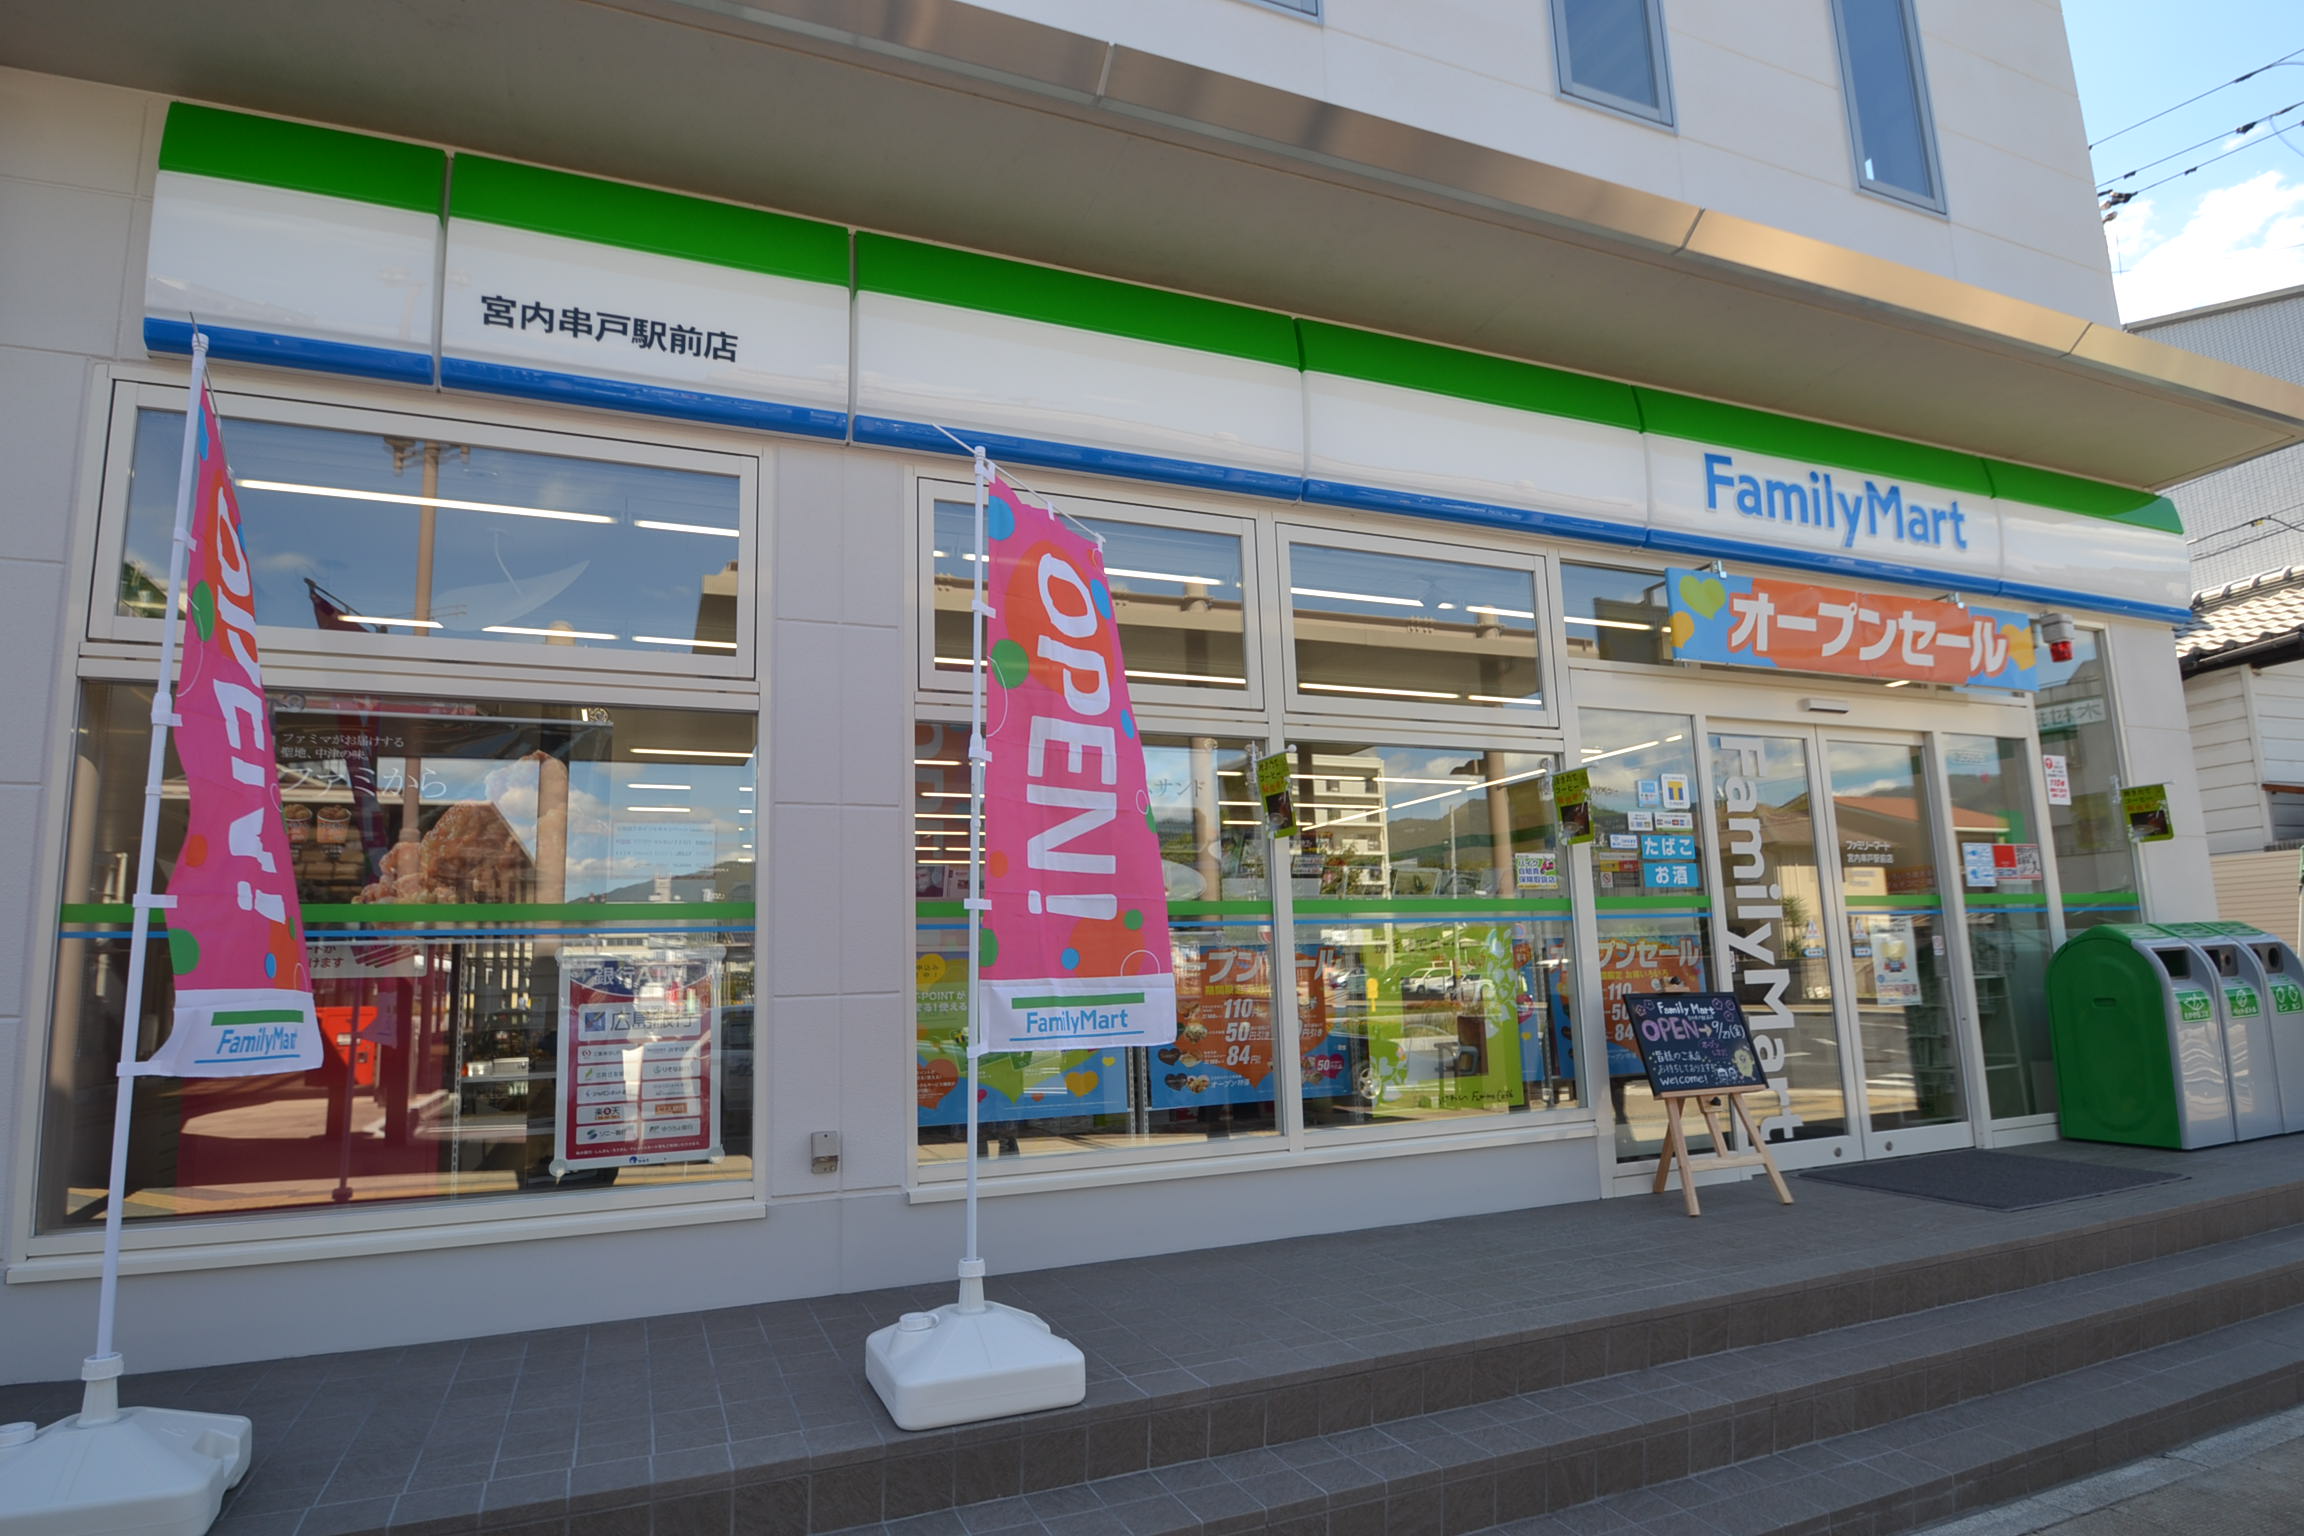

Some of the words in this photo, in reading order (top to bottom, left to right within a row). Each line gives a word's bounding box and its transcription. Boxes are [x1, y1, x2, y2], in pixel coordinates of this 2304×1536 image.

[481, 295, 738, 362] 宮内串戸駅前店
[1704, 452, 1968, 549] FamilyMart
[1731, 592, 2007, 673] オープンセール
[1026, 553, 1118, 920] OPEN!
[1149, 779, 1206, 797] サンド
[1645, 838, 1693, 856] たばこ
[1846, 840, 1891, 850] ファミリーマート
[1655, 866, 1688, 884] お酒
[1224, 999, 1253, 1019] 110
[1657, 1001, 1689, 1015] Family
[1027, 1009, 1128, 1034] FamilyMart
[1641, 1017, 1700, 1041] OPEN
[1225, 1022, 1250, 1042] 50
[1226, 1045, 1250, 1066] 84
